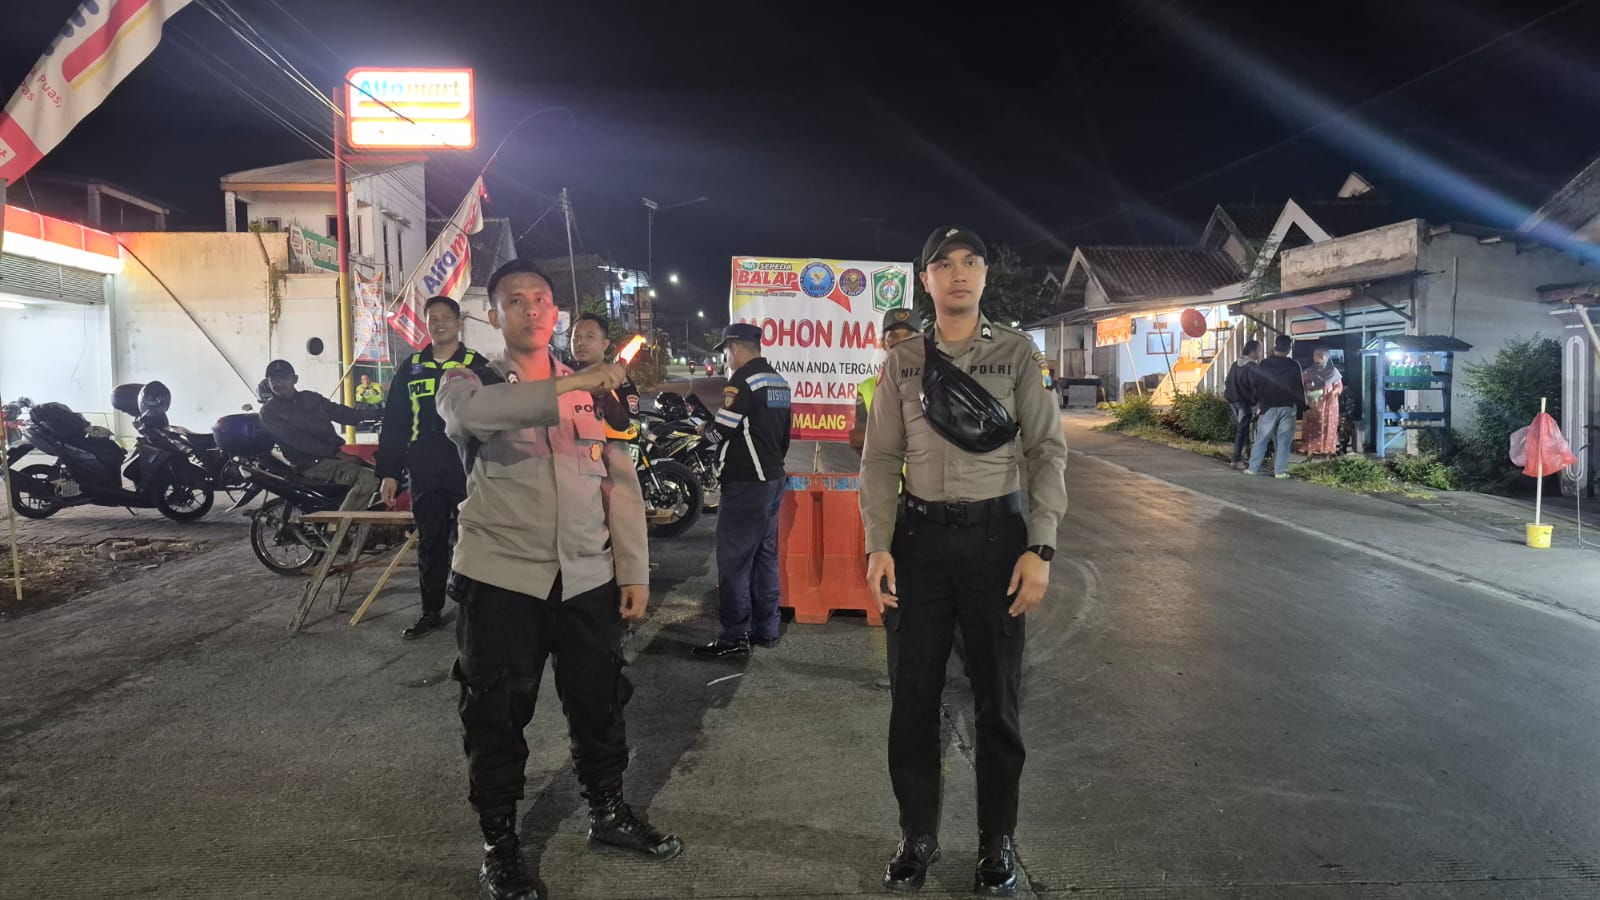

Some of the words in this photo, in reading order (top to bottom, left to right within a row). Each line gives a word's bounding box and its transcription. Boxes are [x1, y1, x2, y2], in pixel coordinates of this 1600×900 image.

[358, 79, 460, 97] Alfamart
[759, 263, 793, 271] SEPEDA
[738, 270, 799, 285] BALAP
[840, 320, 884, 349] MA
[806, 362, 837, 374] ANDA
[969, 364, 1012, 377] POLRI
[410, 381, 432, 395] POL
[794, 381, 824, 398] ADA
[793, 413, 847, 430] MALANG
